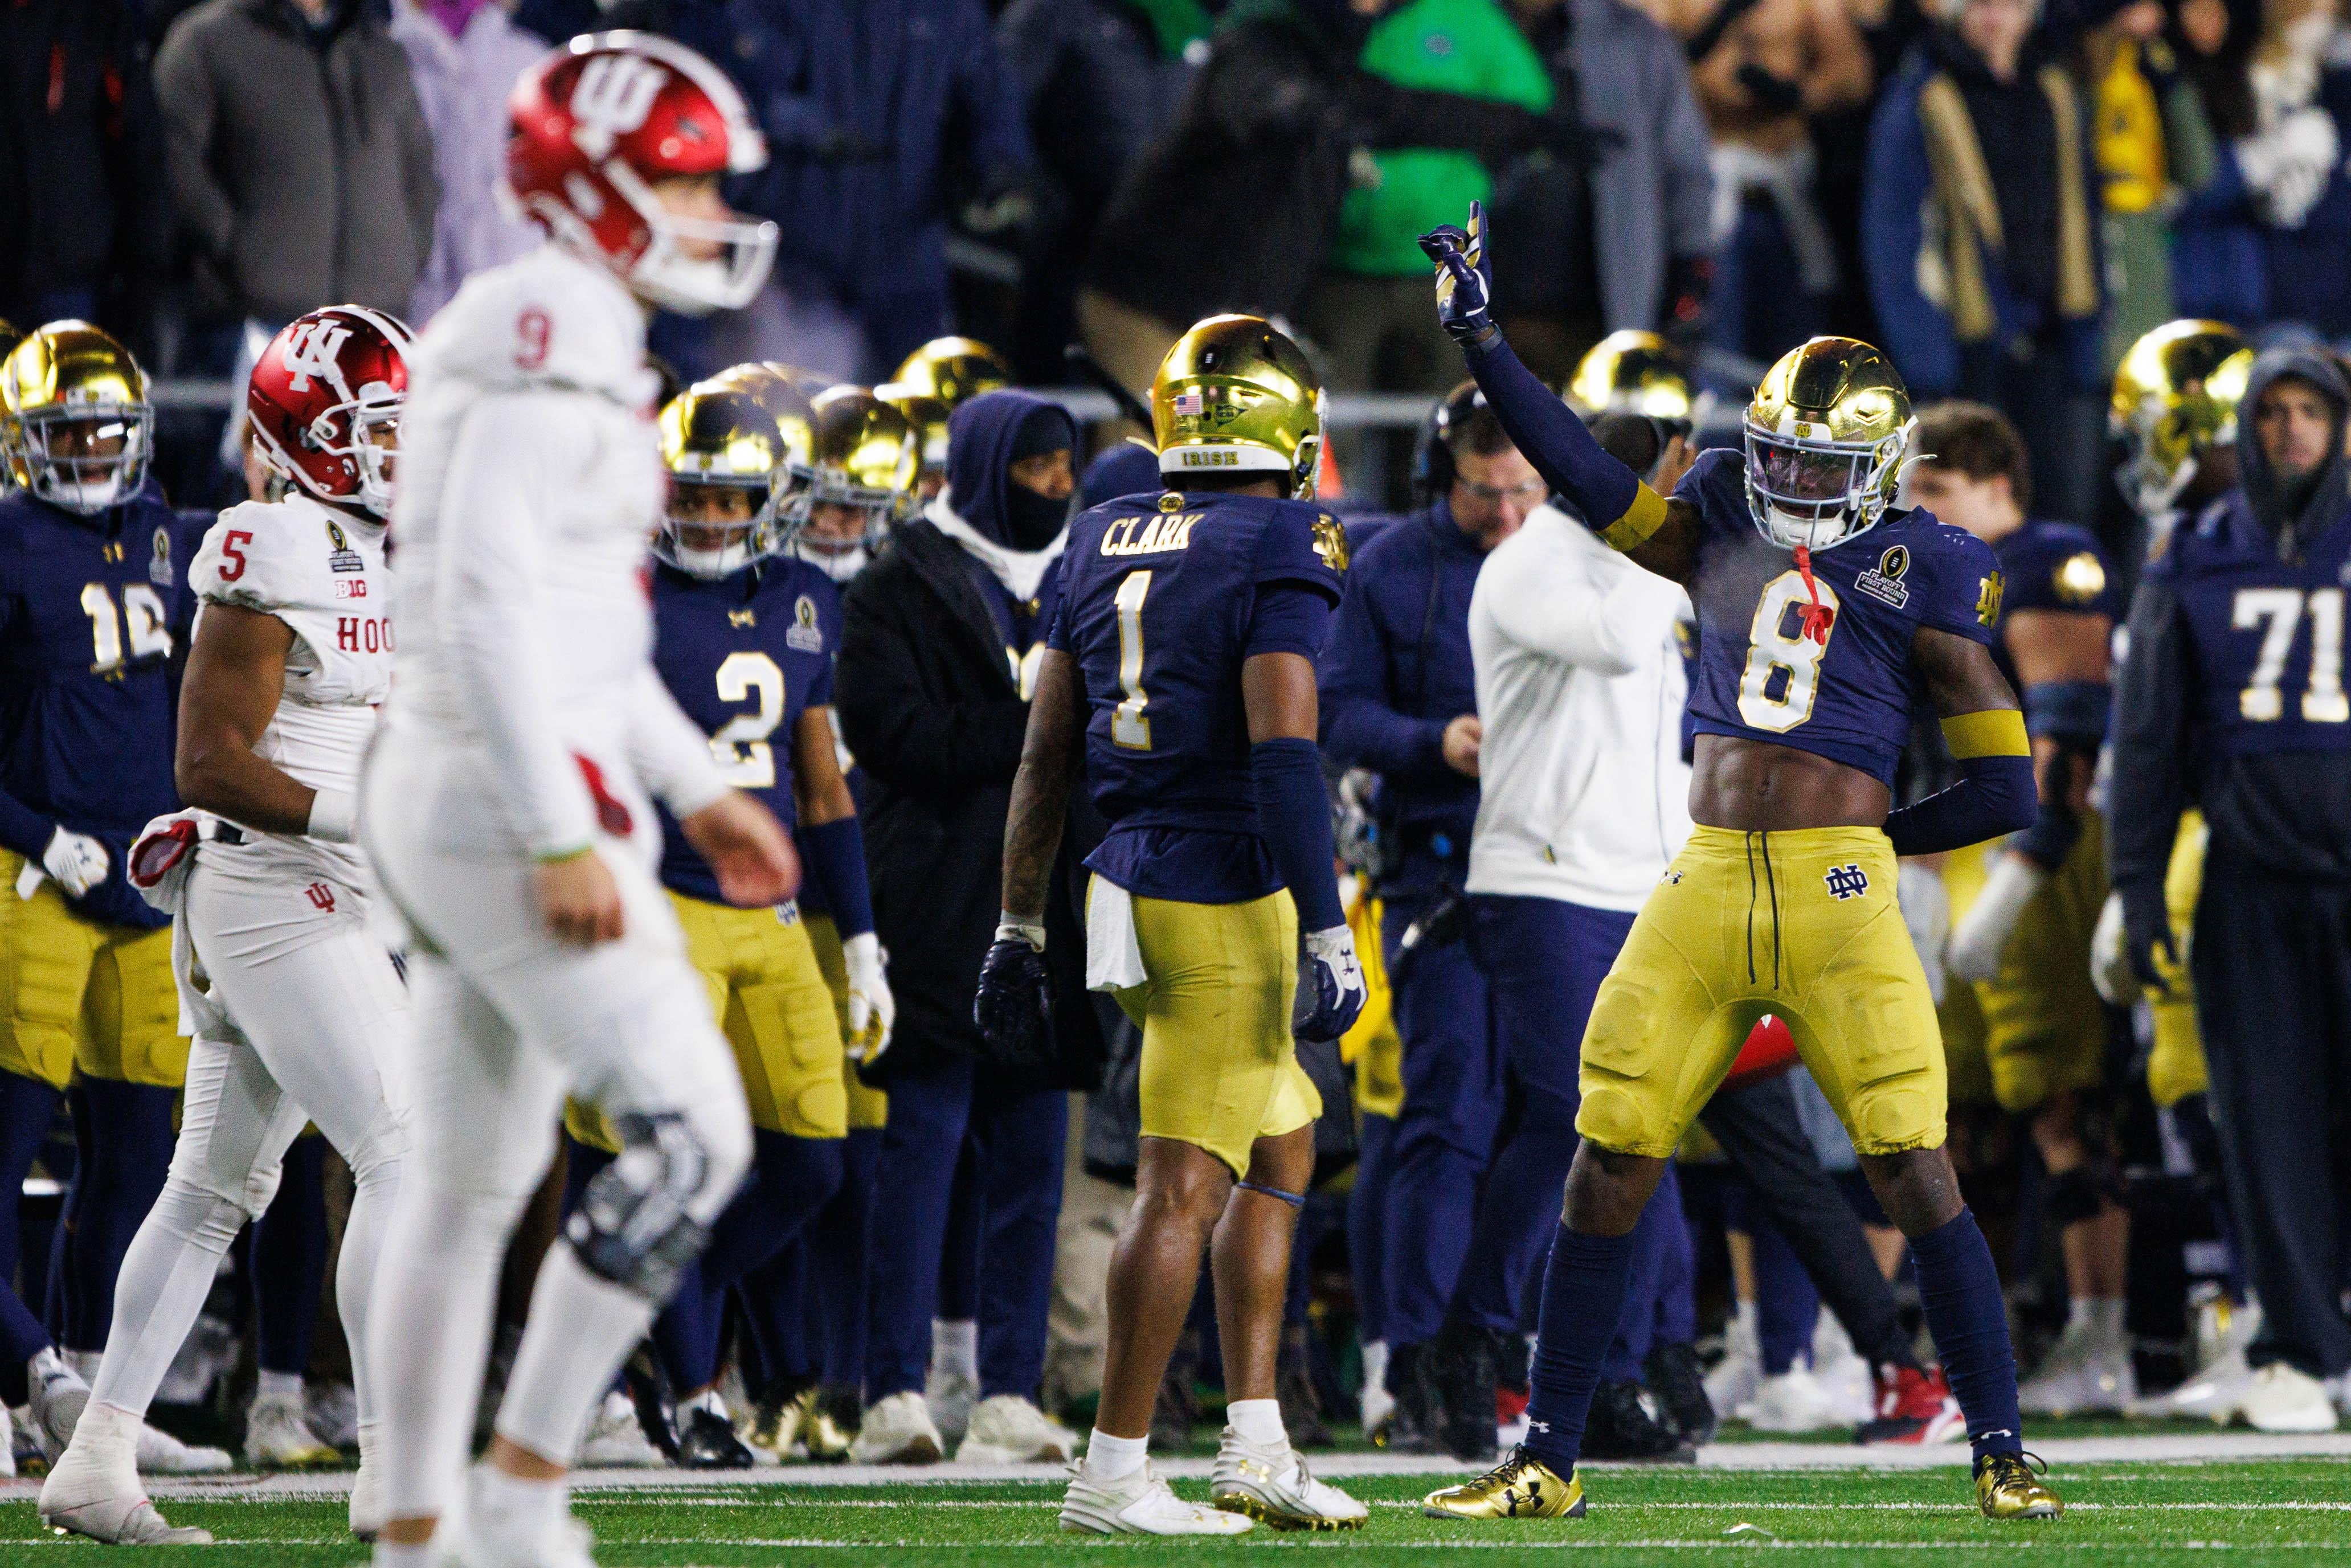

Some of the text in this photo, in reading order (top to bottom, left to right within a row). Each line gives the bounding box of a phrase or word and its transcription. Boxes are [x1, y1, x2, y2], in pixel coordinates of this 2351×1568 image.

[515, 305, 551, 371] 9
[1181, 452, 1239, 466] IRISH
[218, 530, 253, 582] 5
[1100, 513, 1205, 556] CLARK
[1861, 575, 1905, 599] FIRST ROUND
[1871, 572, 1901, 589] PLAYOFF
[1111, 570, 1152, 751] 1
[1737, 570, 1840, 734] 8
[2230, 588, 2349, 722] 71
[709, 652, 786, 788] 2
